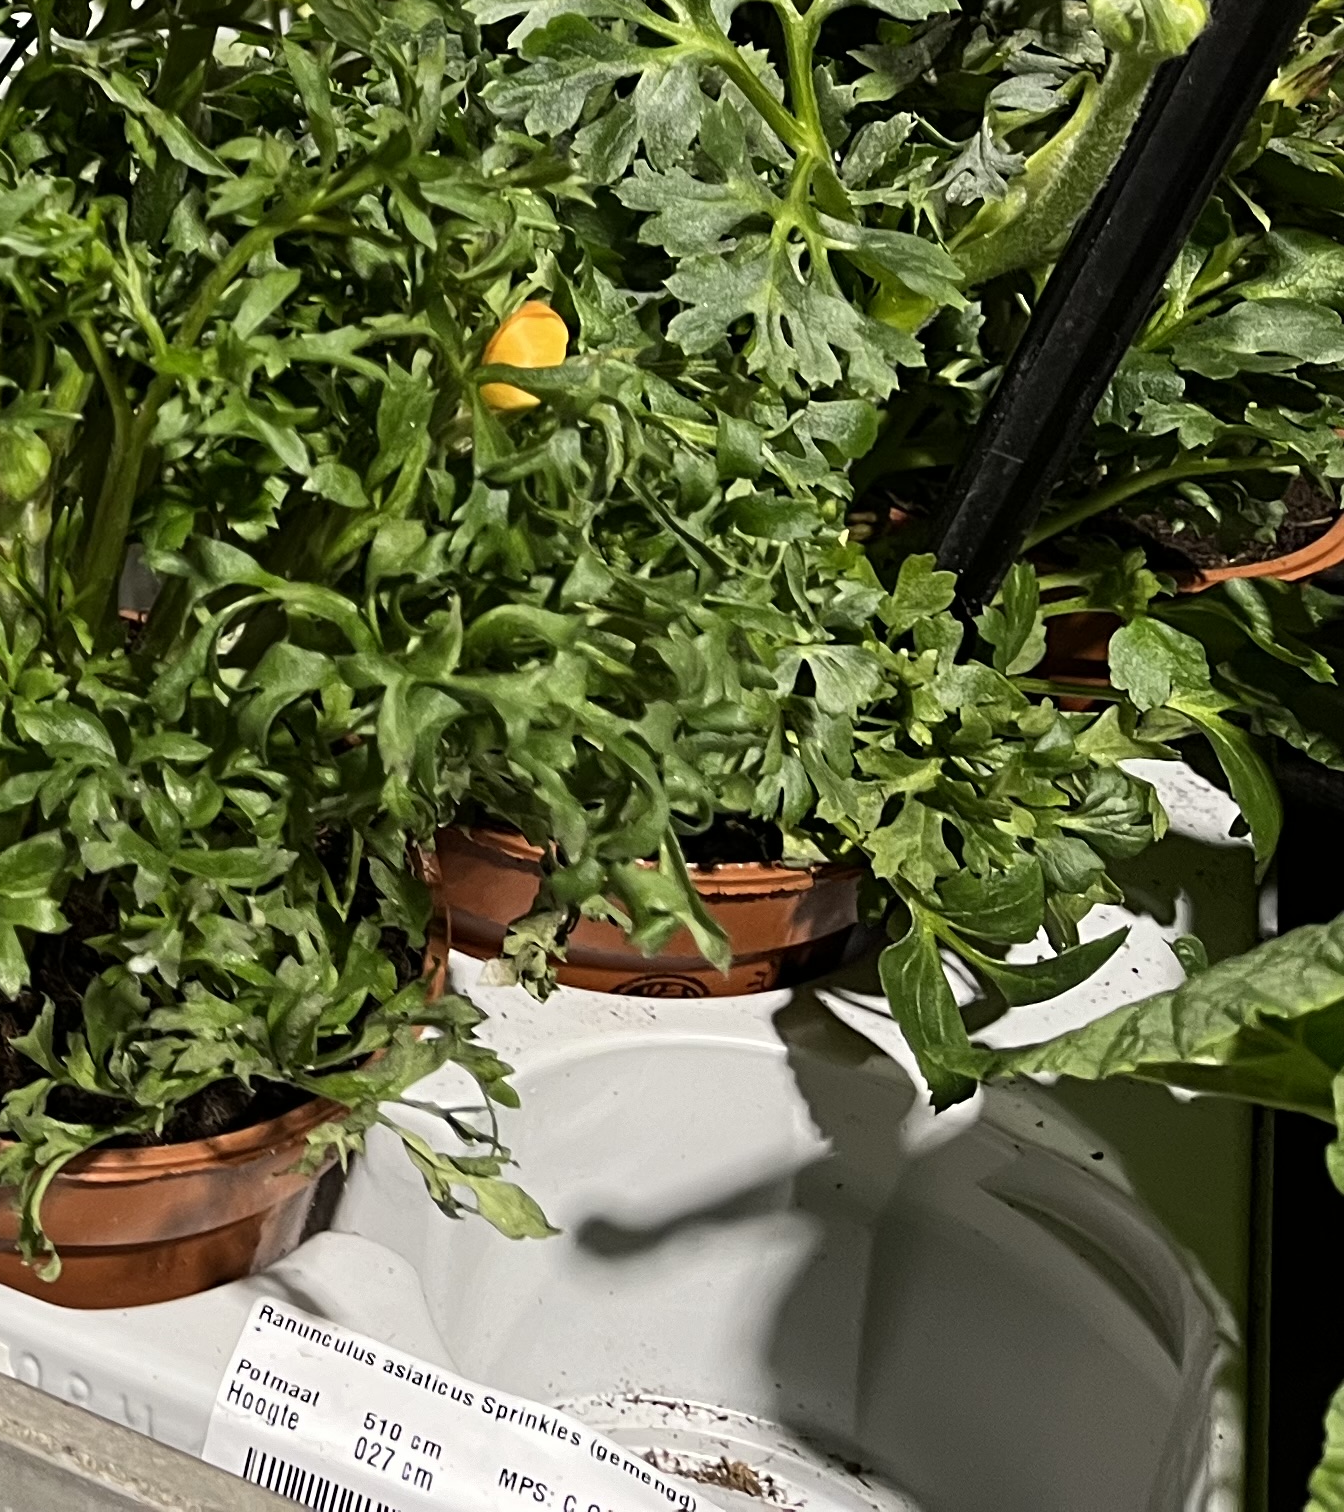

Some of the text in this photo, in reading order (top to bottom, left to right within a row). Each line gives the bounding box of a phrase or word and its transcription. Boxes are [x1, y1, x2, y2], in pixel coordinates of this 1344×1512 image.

[226, 1379, 434, 1492] Hoogte 027 cm
[236, 1358, 443, 1461] Potmaat 510 cm
[258, 1304, 698, 1512] Ranunculus asiaticus Sprinkles (gemengd)
[498, 1468, 556, 1508] MPS:
